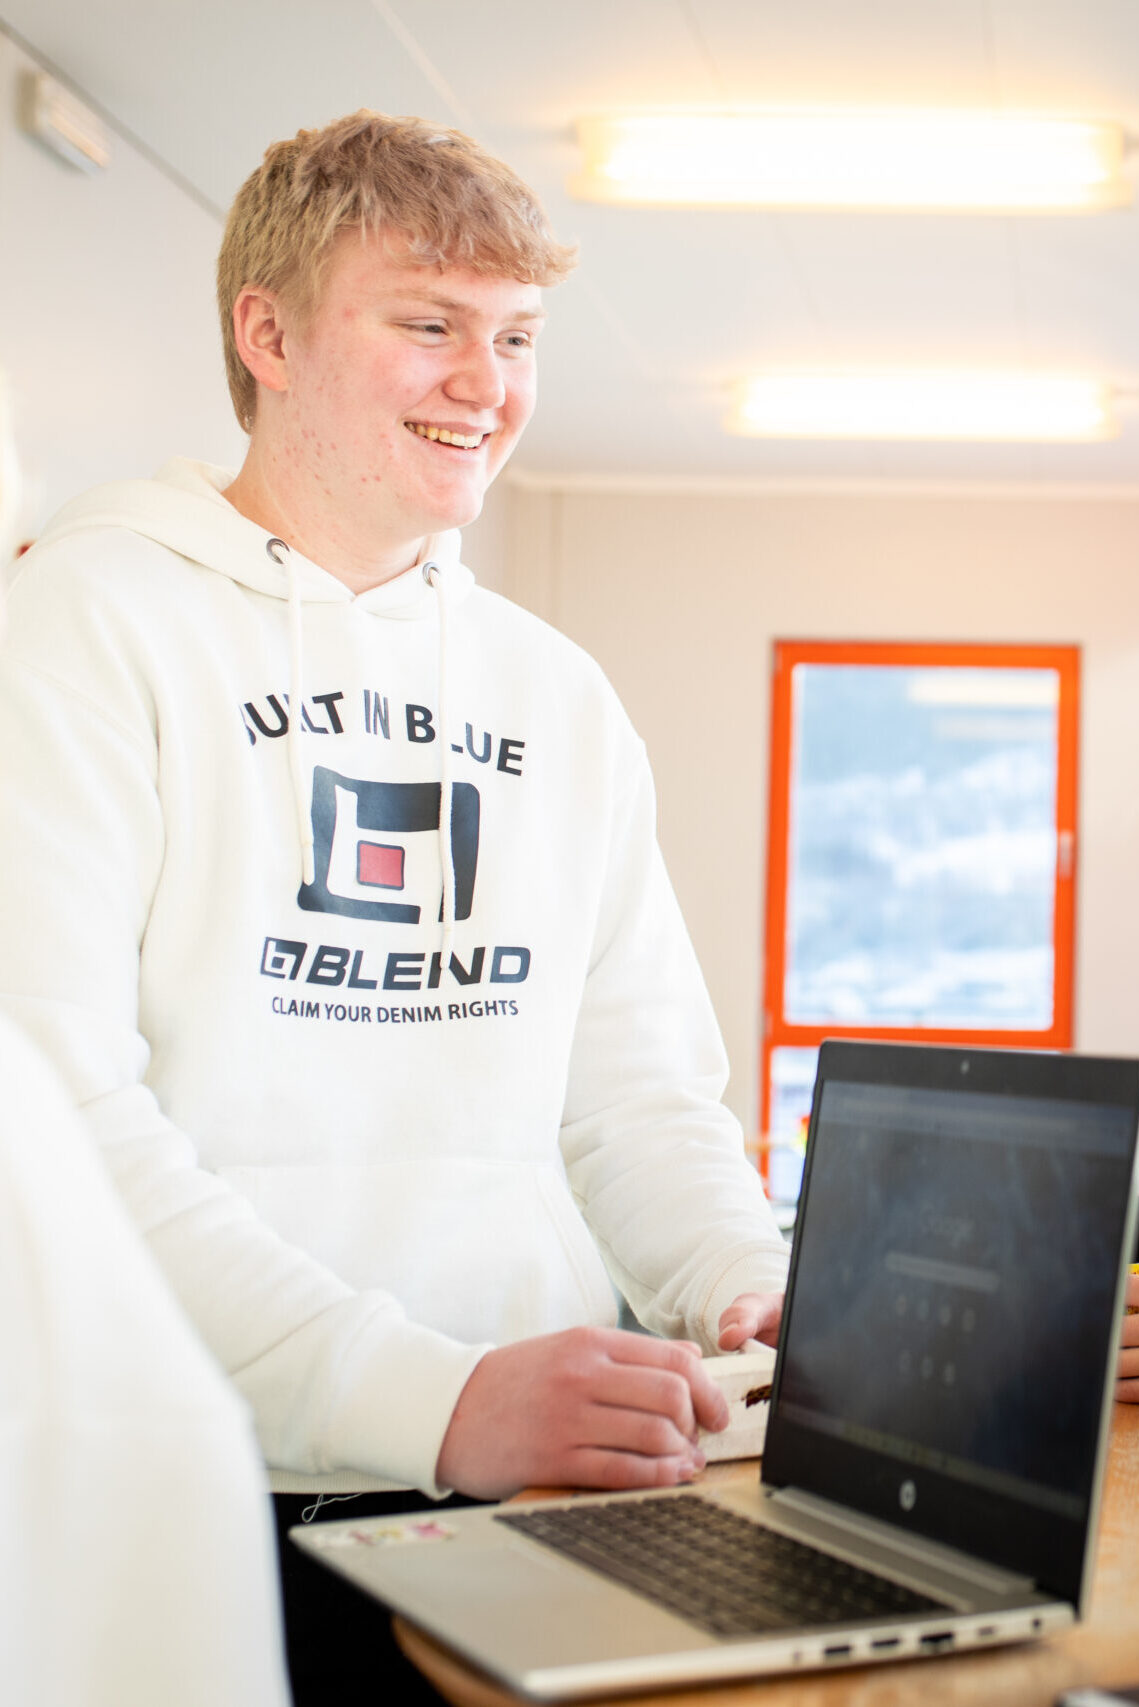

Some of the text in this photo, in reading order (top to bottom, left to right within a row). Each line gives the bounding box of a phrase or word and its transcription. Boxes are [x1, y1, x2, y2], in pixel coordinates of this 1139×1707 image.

[238, 691, 345, 746] ULT
[363, 688, 391, 741] IN
[305, 944, 532, 991] BLEND
[271, 996, 520, 1024] CLAIM YOUR DENIM RIGHTS
